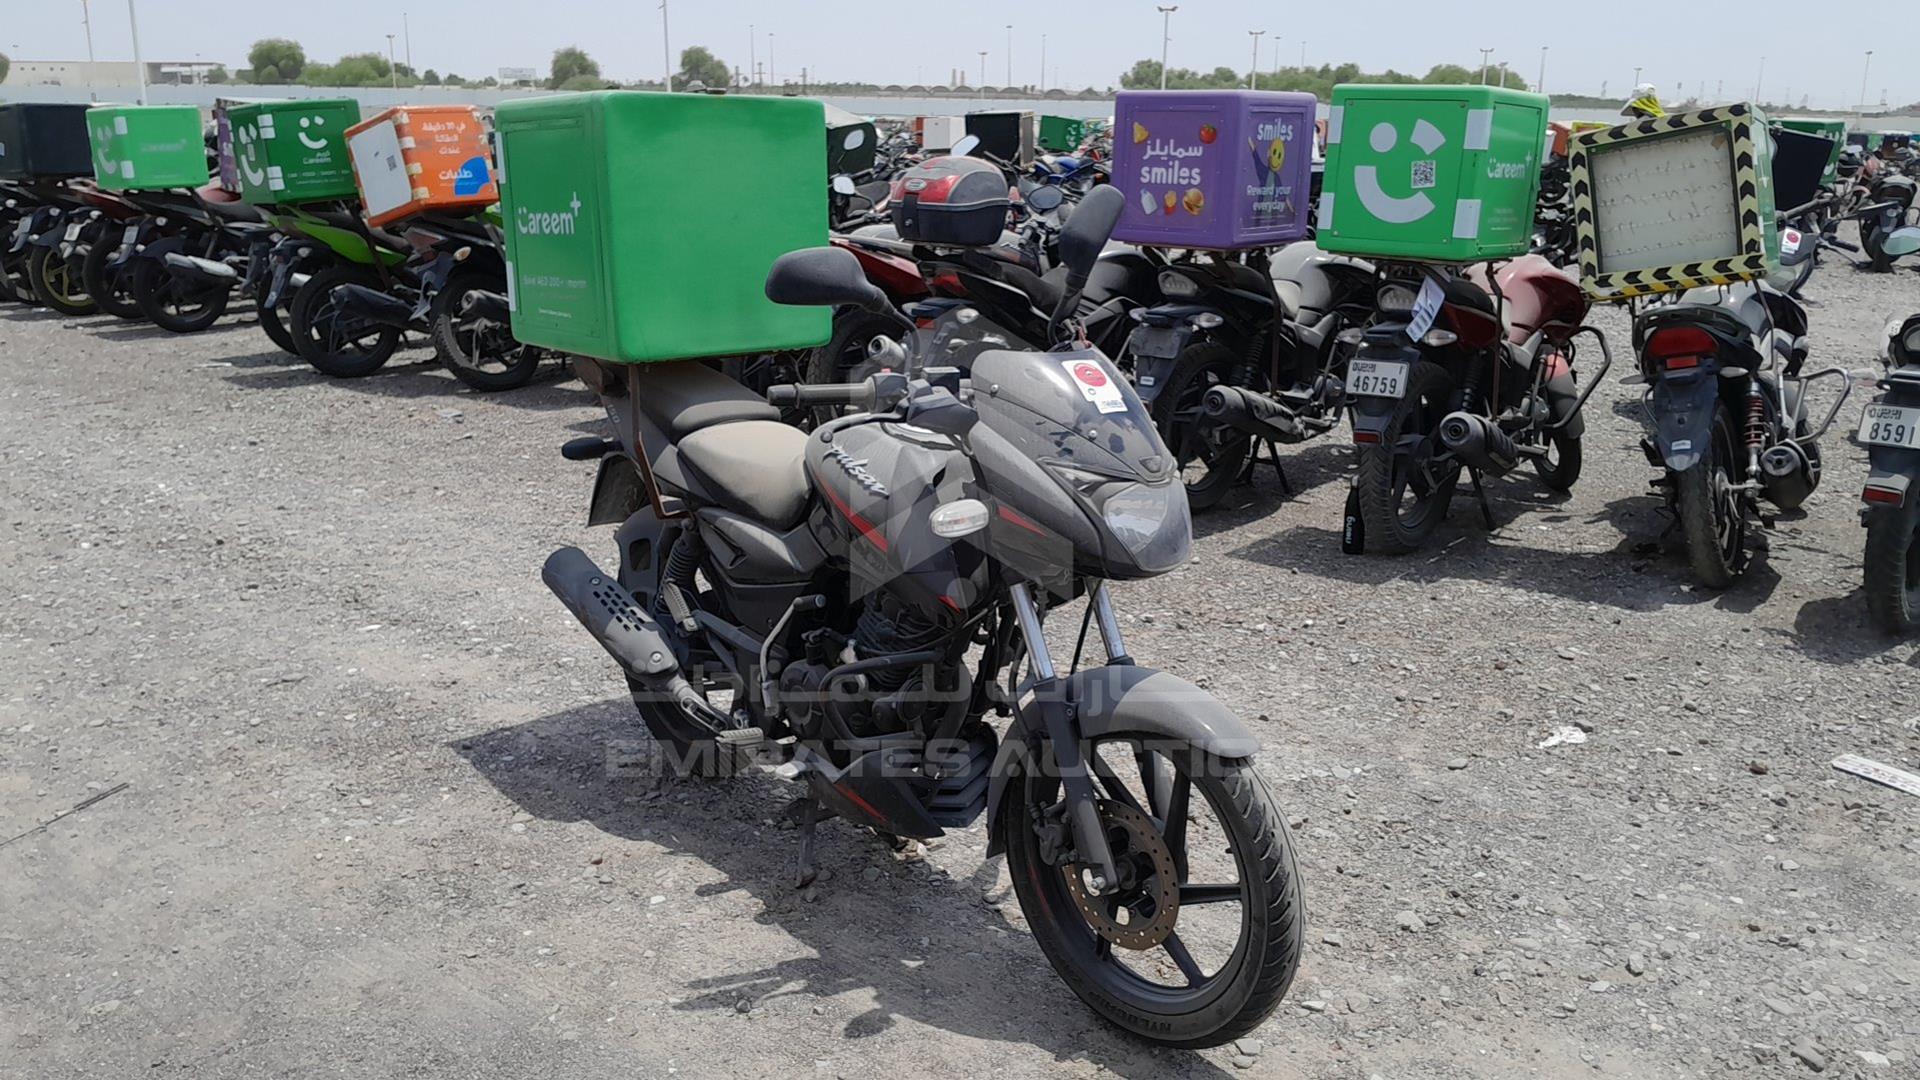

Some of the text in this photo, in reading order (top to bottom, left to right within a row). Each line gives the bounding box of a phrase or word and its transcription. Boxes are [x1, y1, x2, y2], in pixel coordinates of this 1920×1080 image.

[1257, 118, 1293, 141] smiles
[1143, 139, 1203, 160] سمايلز
[1140, 161, 1201, 185] smiles
[1353, 375, 1397, 394] 46759
